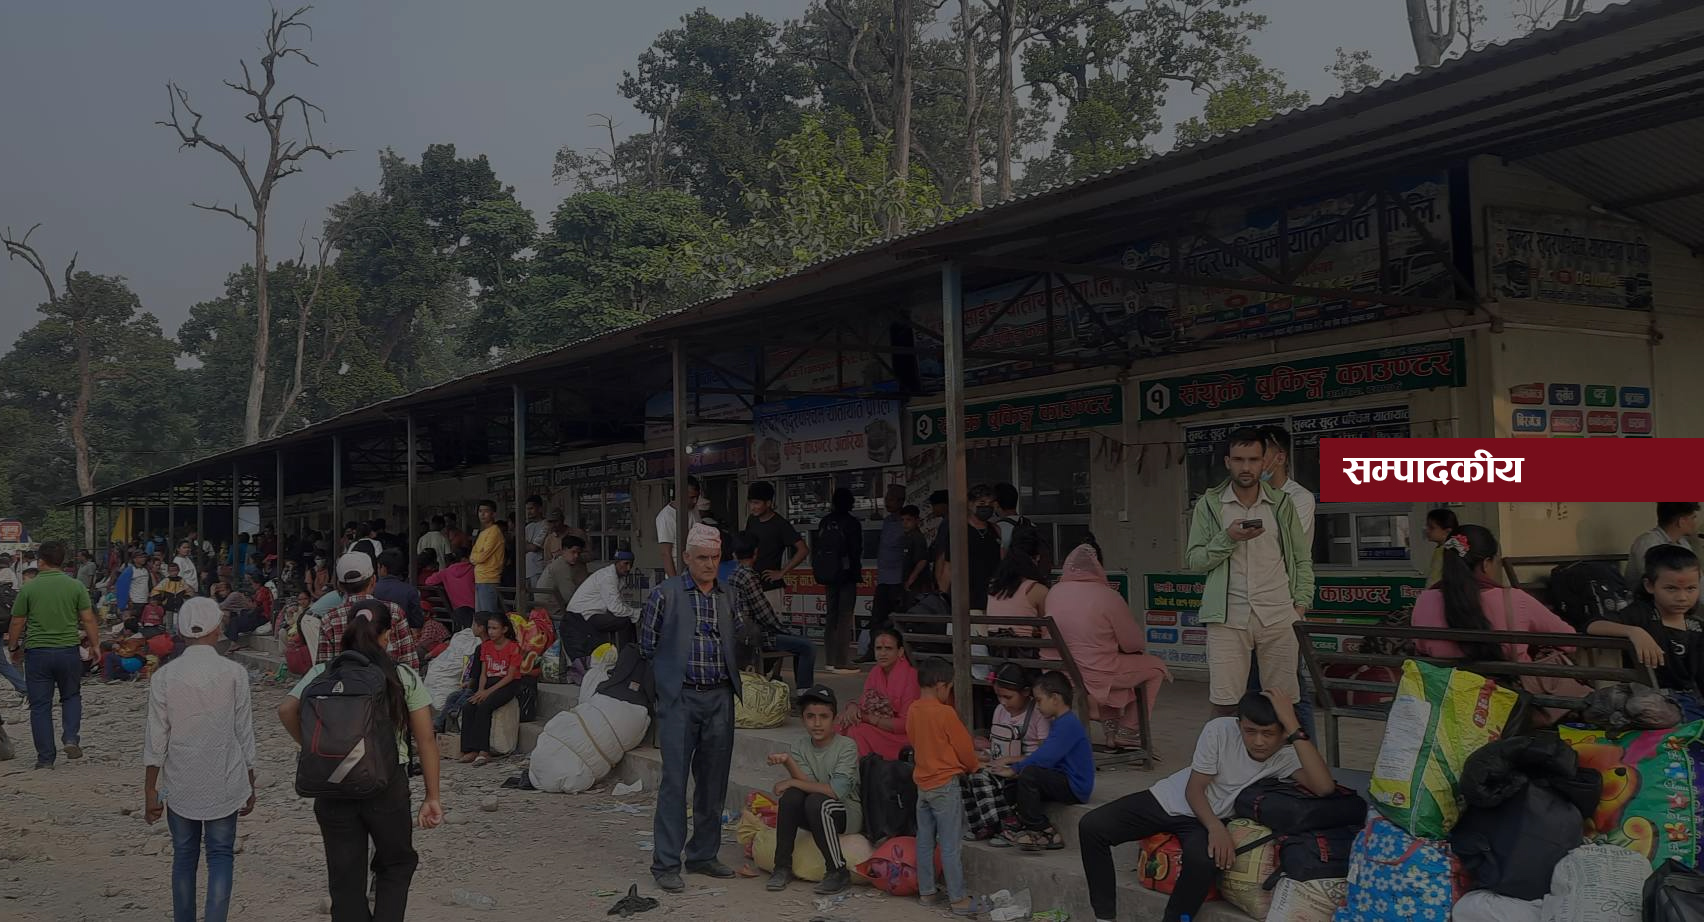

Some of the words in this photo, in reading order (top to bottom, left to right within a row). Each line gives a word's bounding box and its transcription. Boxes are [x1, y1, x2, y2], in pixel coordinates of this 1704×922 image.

[1336, 350, 1454, 385] काउण्टर
[919, 419, 929, 435] २
[1039, 395, 1113, 422] काउण्टर
[1341, 410, 1370, 425] पश्चिम
[1319, 585, 1391, 604] काउण्टर
